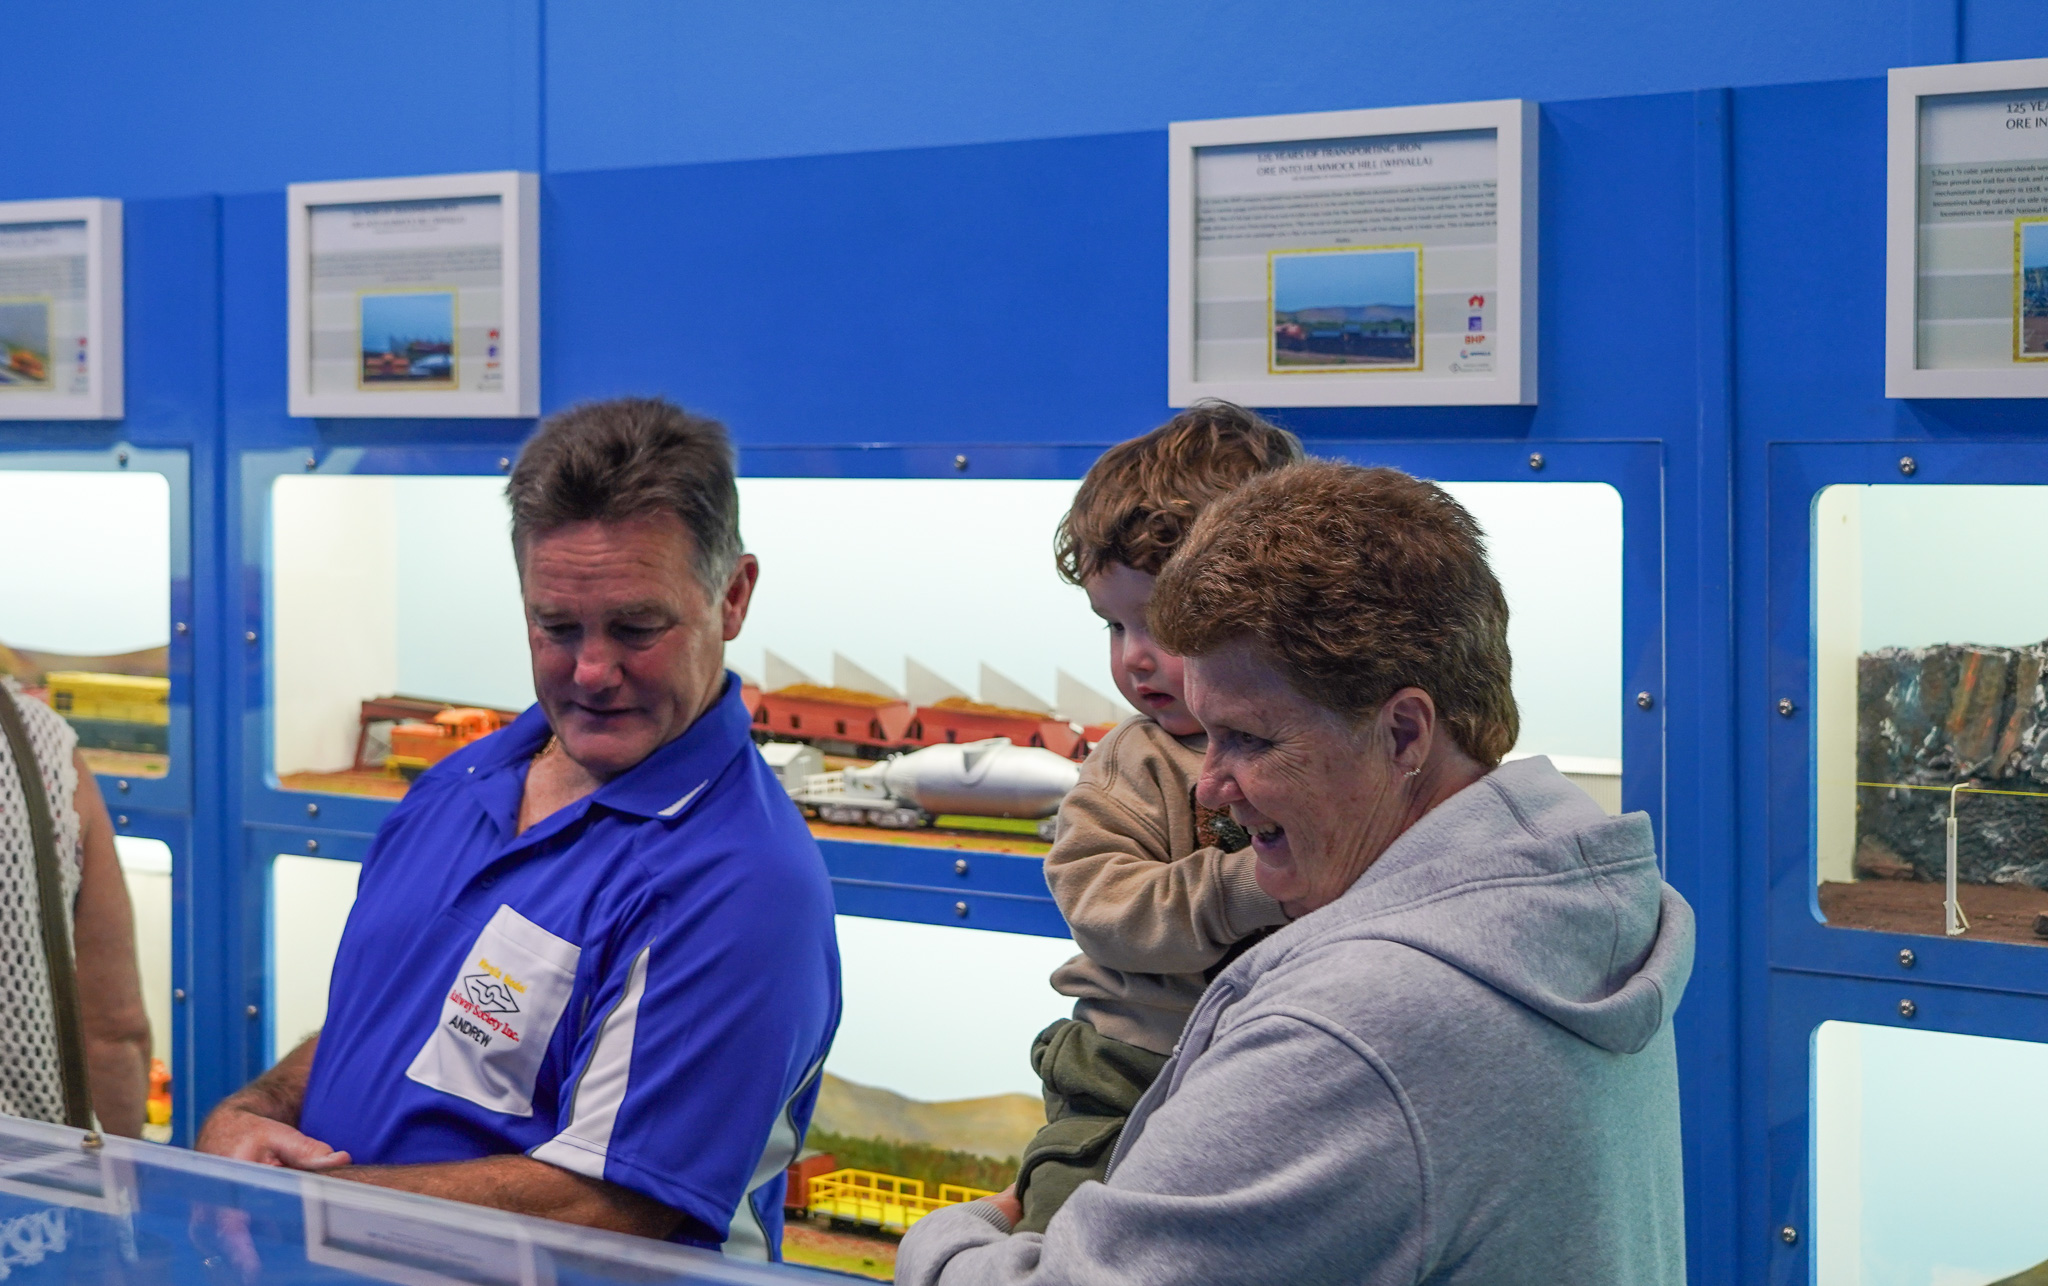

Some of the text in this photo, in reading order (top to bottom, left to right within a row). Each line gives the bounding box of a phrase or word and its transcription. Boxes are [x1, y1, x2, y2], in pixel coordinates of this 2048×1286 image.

[2007, 103, 2026, 114] 125
[2006, 116, 2048, 130] ORE IN
[1464, 335, 1485, 345] BHP
[473, 1005, 502, 1031] Society
[502, 1023, 520, 1042] Inc.
[449, 1015, 492, 1048] ANDREW
